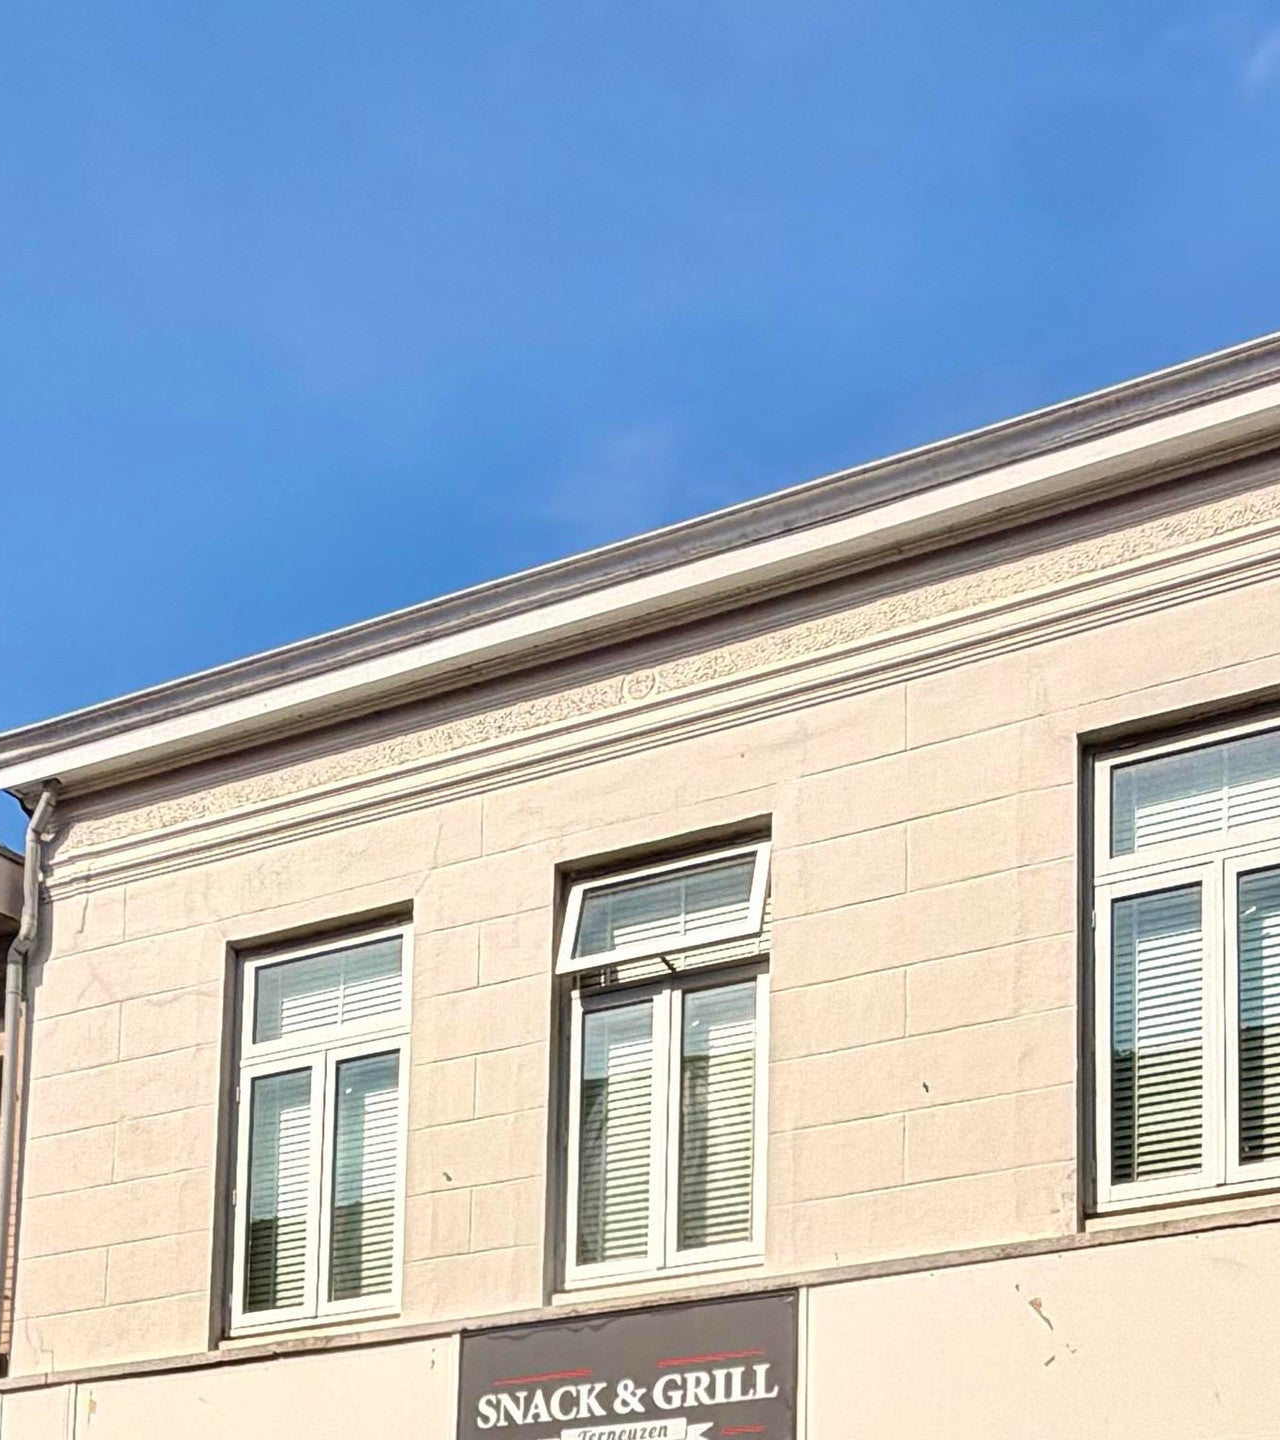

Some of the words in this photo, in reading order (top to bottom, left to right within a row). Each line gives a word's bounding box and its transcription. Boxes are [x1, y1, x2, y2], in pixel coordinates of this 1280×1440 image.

[476, 1382, 608, 1430] SNACK
[612, 1379, 648, 1415] &
[652, 1363, 779, 1411] GRILL
